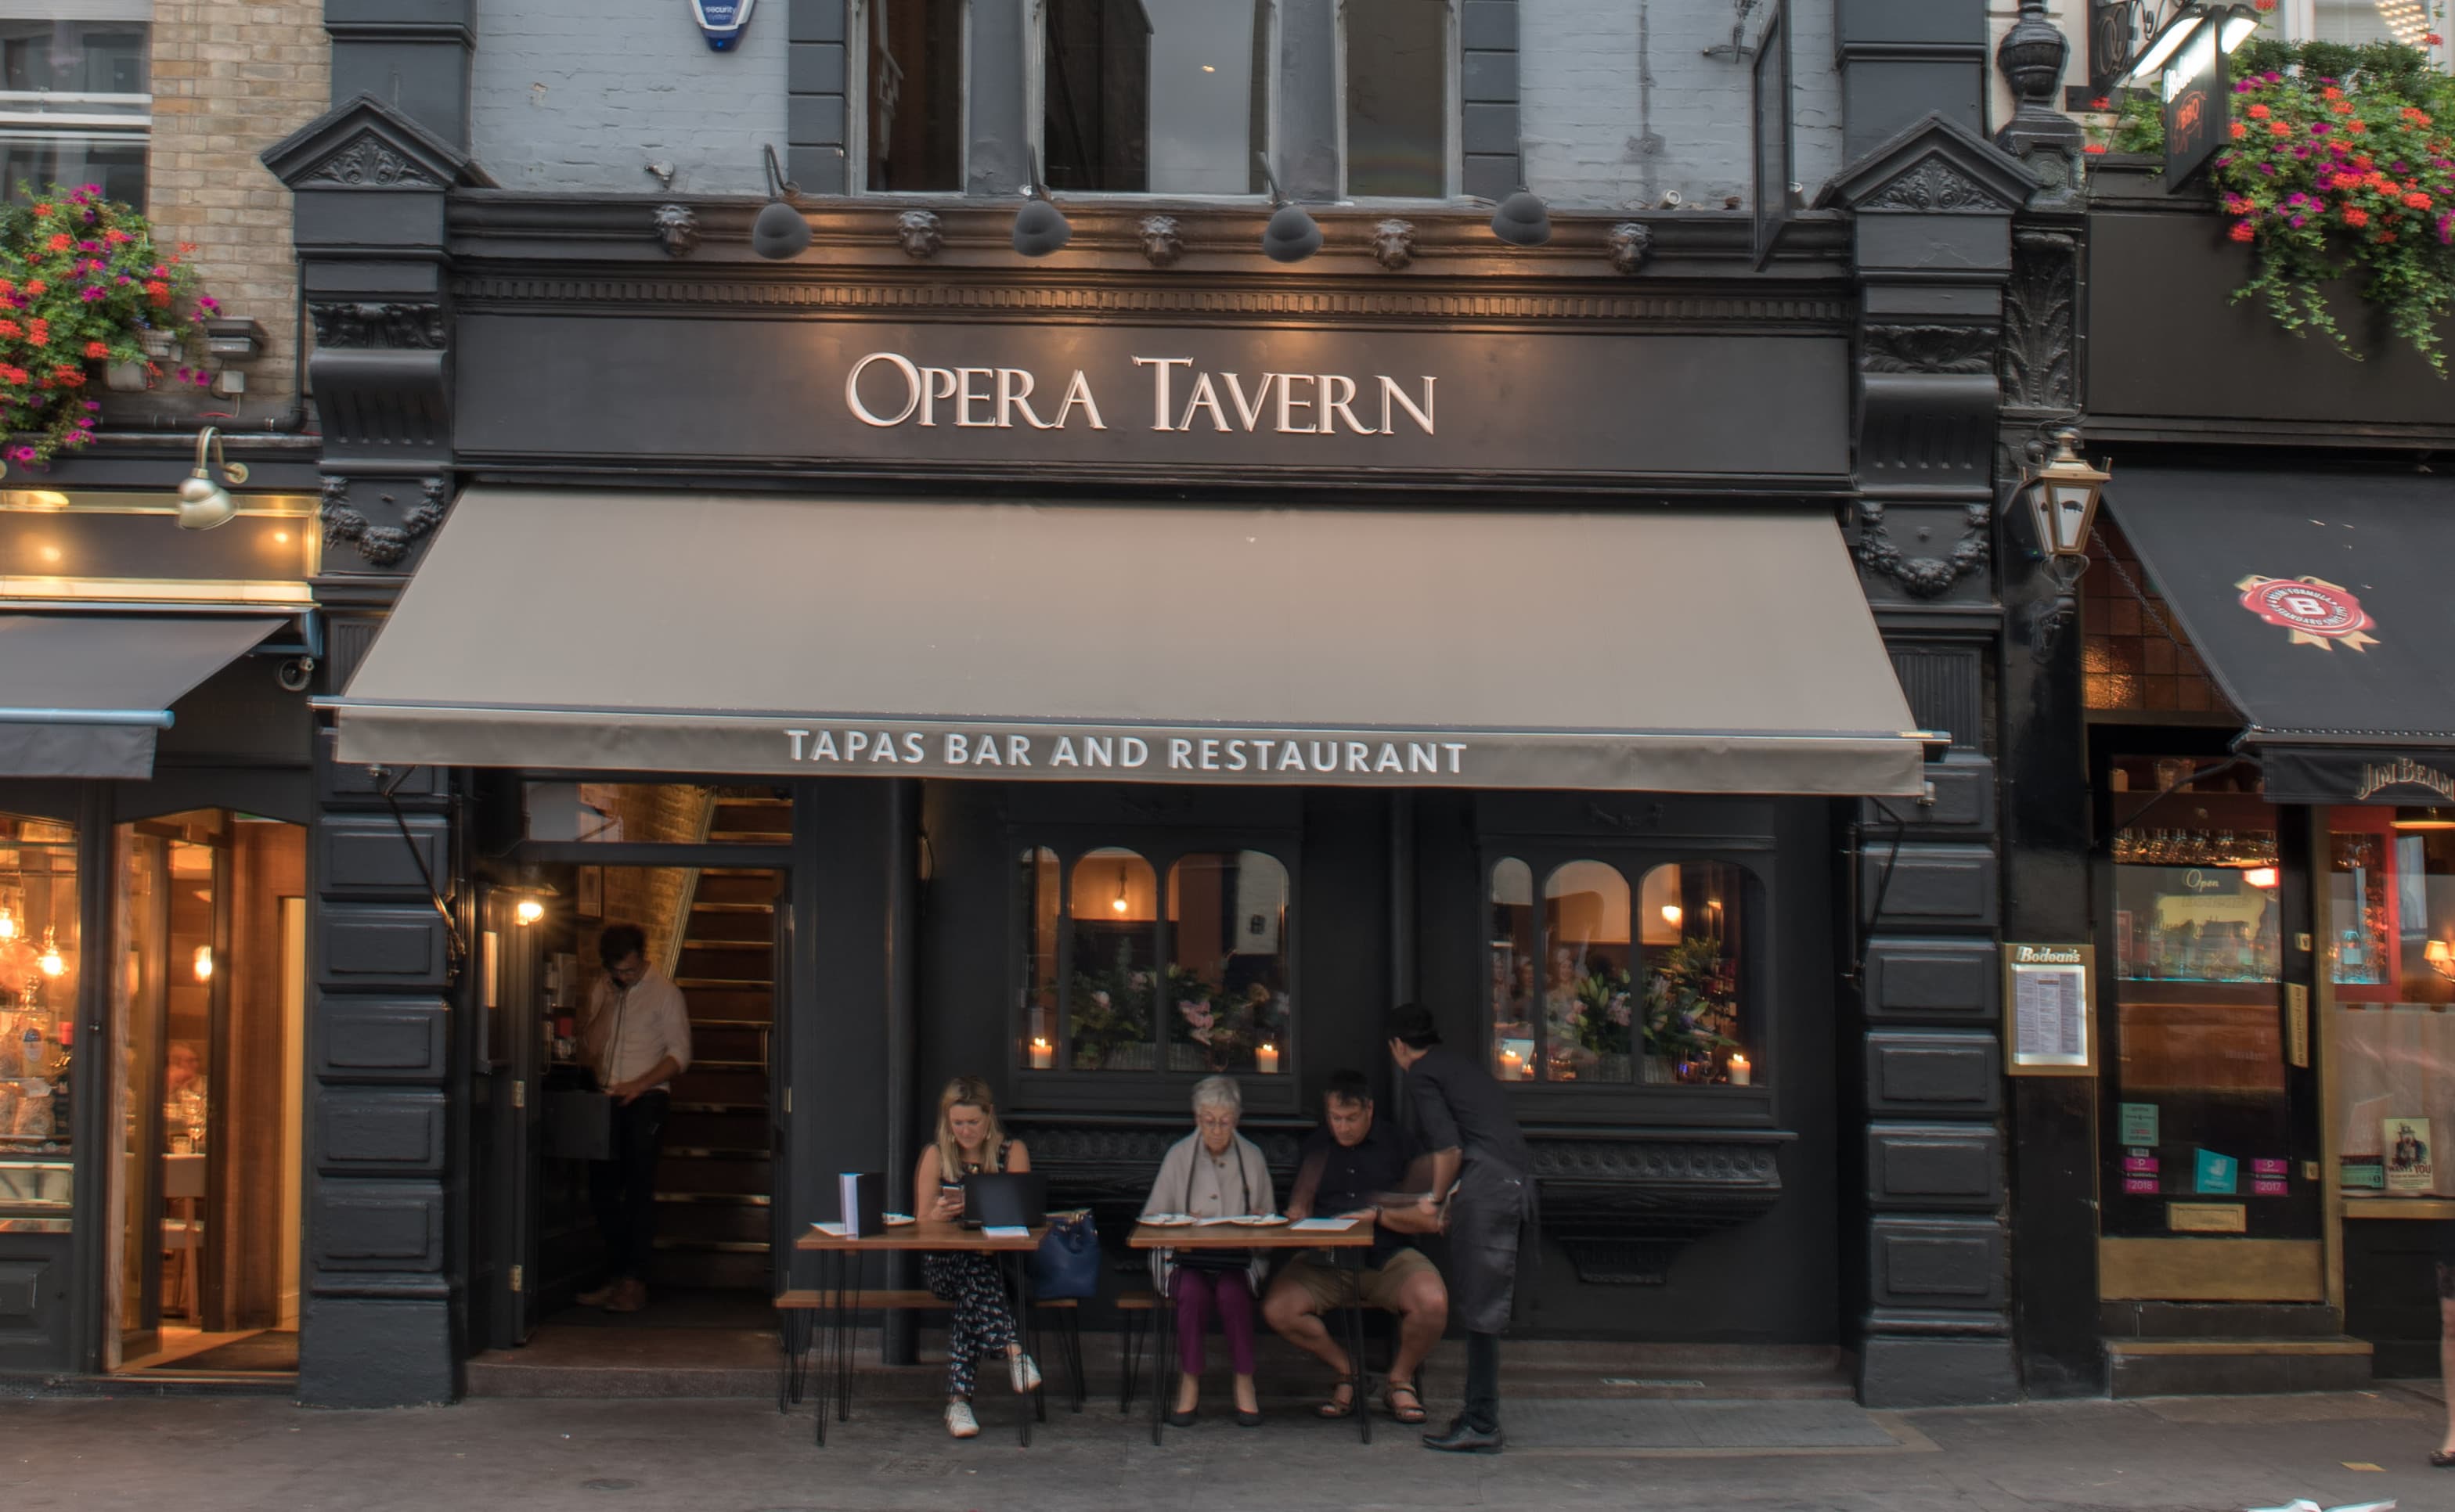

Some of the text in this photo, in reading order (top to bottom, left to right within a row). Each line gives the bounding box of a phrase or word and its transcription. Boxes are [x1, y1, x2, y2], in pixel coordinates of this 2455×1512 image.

[845, 351, 1437, 435] OPERA TAVERN
[2284, 597, 2327, 615] B
[784, 729, 1467, 773] TAPAS BAR AND RESTAURANT
[2354, 762, 2398, 800] JIM
[2185, 869, 2219, 892] Open
[2018, 946, 2081, 963] Bodean's
[2260, 1182, 2282, 1191] 2017
